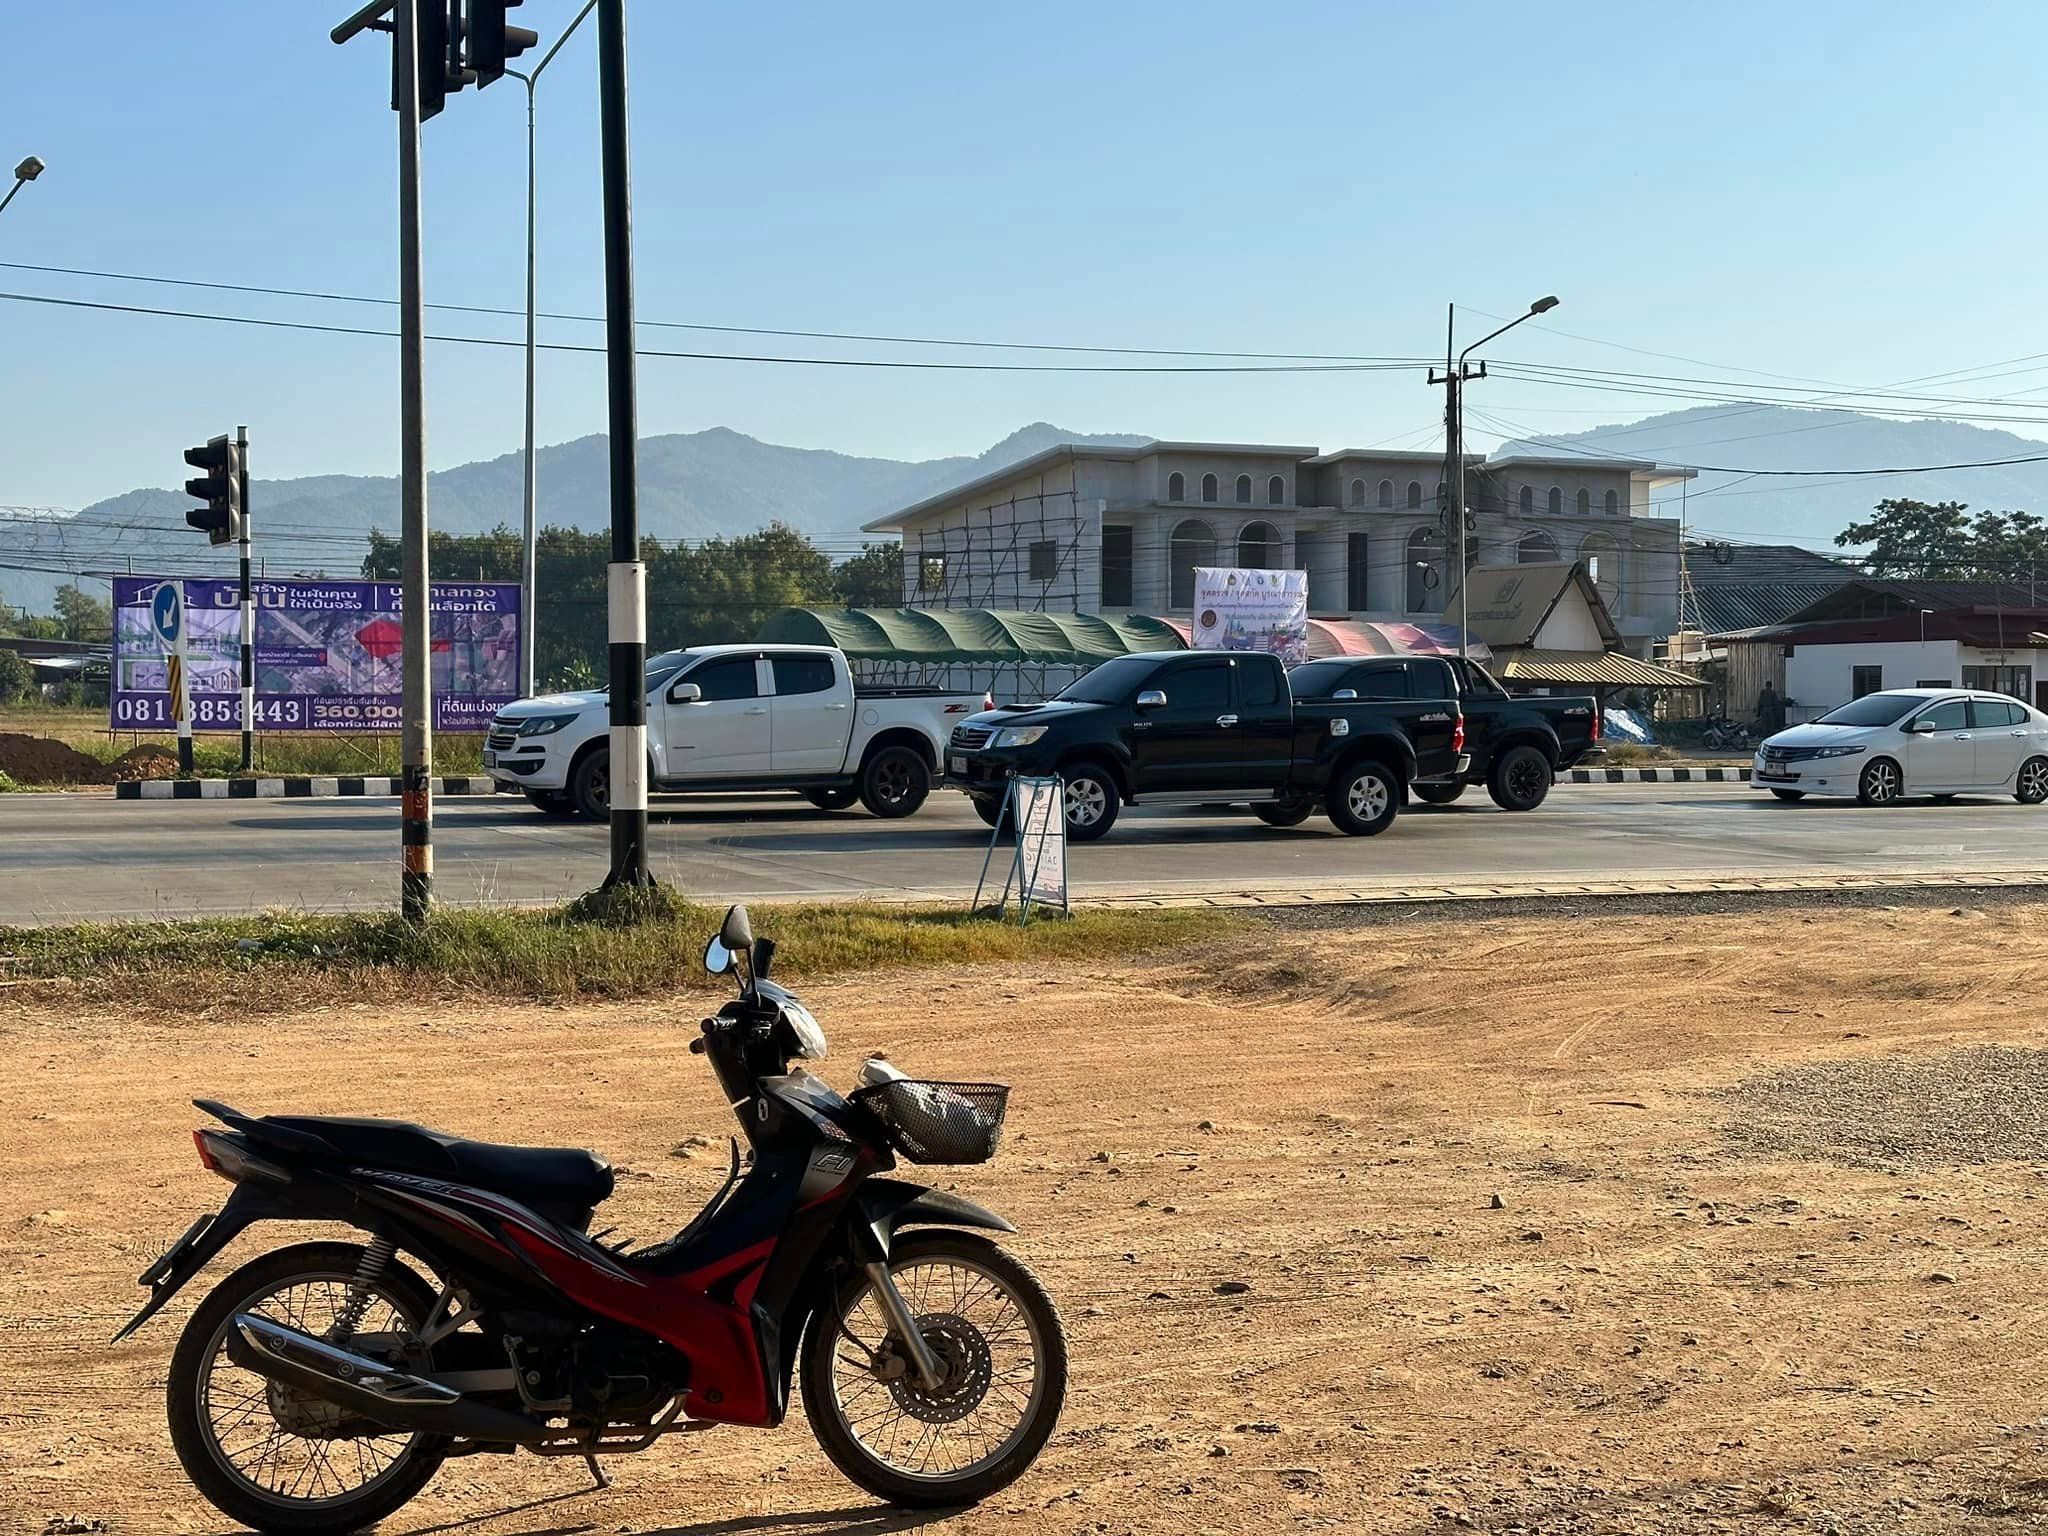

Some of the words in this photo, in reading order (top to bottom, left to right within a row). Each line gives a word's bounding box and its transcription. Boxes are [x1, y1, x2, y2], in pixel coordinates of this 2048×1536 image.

[290, 599, 362, 609] ให้เป็นจริง
[117, 699, 300, 722] 081858443
[313, 705, 403, 719] 360,00
[815, 1152, 850, 1170] FI
